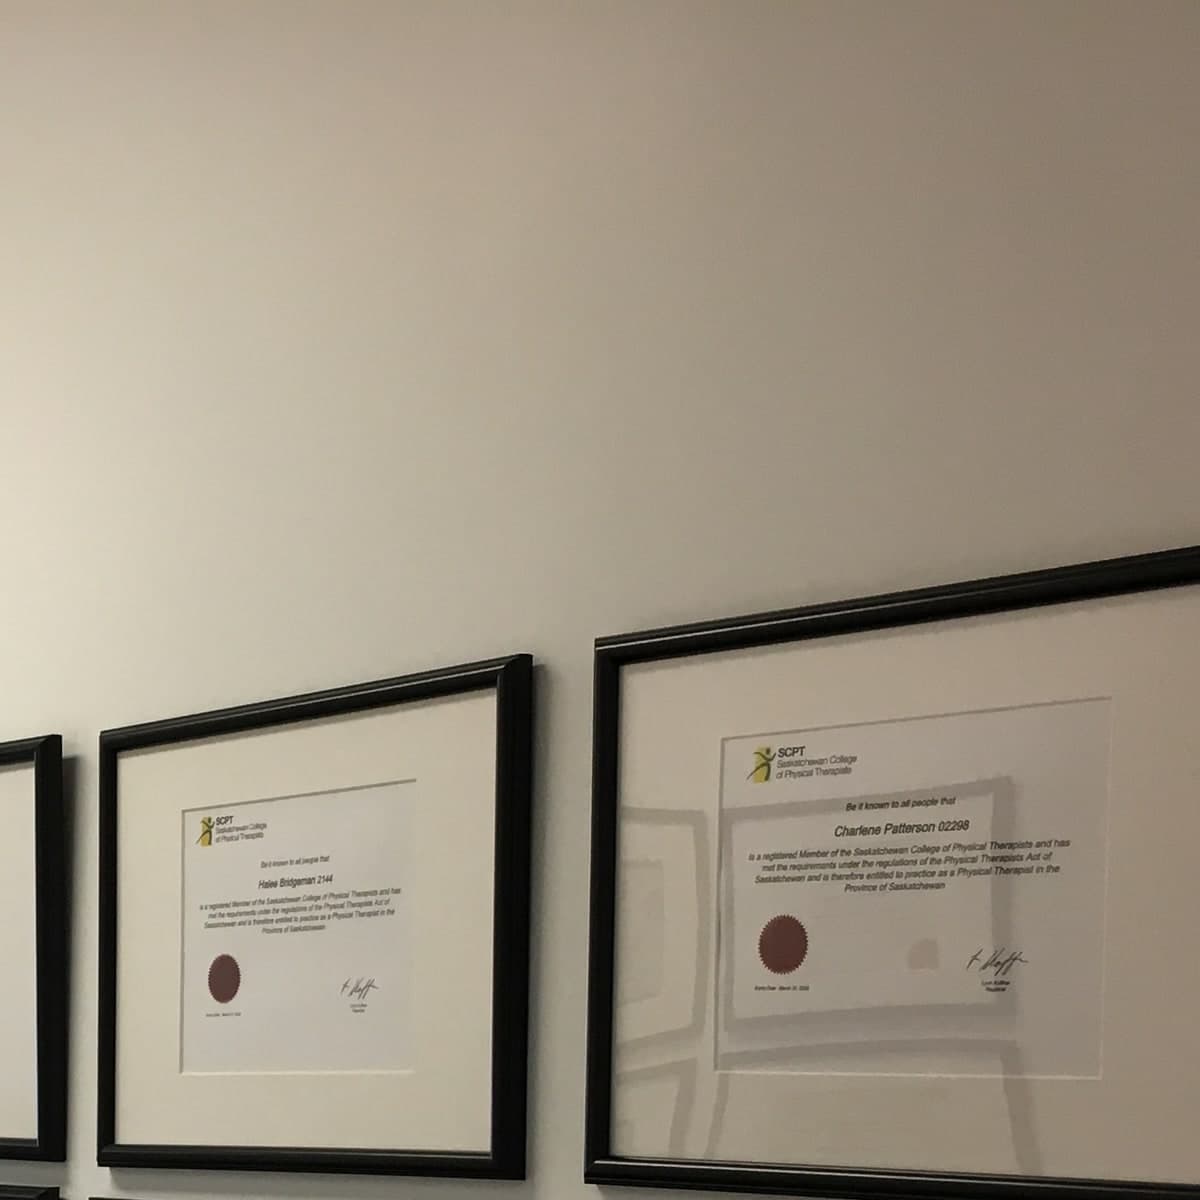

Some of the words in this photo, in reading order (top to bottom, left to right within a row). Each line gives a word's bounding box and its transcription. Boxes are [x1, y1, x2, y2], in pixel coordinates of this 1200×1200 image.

[778, 746, 806, 758] SCPT
[777, 758, 828, 768] Saskatchewan
[830, 755, 857, 765] College
[776, 771, 783, 779] of
[784, 769, 813, 779] Physical
[815, 766, 852, 776] Therapists
[846, 803, 856, 811] Be
[858, 802, 863, 810] it
[864, 802, 890, 810] known
[900, 799, 910, 807] all
[911, 797, 939, 808] people
[940, 796, 956, 805] that
[216, 816, 234, 826] SCPT
[834, 825, 881, 837] Charlene
[884, 823, 936, 835] Patterson
[938, 820, 970, 832] 02298
[763, 851, 798, 862] registered
[799, 850, 828, 858] Member
[830, 849, 839, 857] of
[853, 847, 909, 856] Saskatchewan
[911, 845, 941, 855] College
[942, 843, 952, 852] of
[952, 842, 987, 853] Physical
[990, 841, 1033, 850] Therapists
[1035, 840, 1052, 848] and
[789, 862, 836, 872] requirements
[838, 861, 860, 869] under
[862, 860, 874, 868] the
[875, 859, 918, 869] regulations
[919, 856, 929, 865] of
[929, 857, 942, 865] the
[944, 856, 978, 866] Physical
[982, 854, 1024, 863] Therapists
[1025, 852, 1040, 861] Act
[1042, 852, 1053, 860] of
[258, 880, 278, 888] Halee
[280, 877, 316, 888] Bridgeman
[317, 874, 333, 884] 2144
[755, 875, 805, 883] Saskatchewan
[807, 873, 822, 881] and
[831, 872, 864, 880] therefore
[866, 871, 894, 880] entitled
[904, 870, 936, 880] practice
[957, 866, 992, 877] Physical
[995, 866, 1034, 875] Therapist
[1036, 866, 1044, 874] in
[1046, 865, 1060, 873] the
[844, 884, 877, 892] Province
[879, 883, 888, 891] of
[888, 882, 945, 891] Saskatchewan
